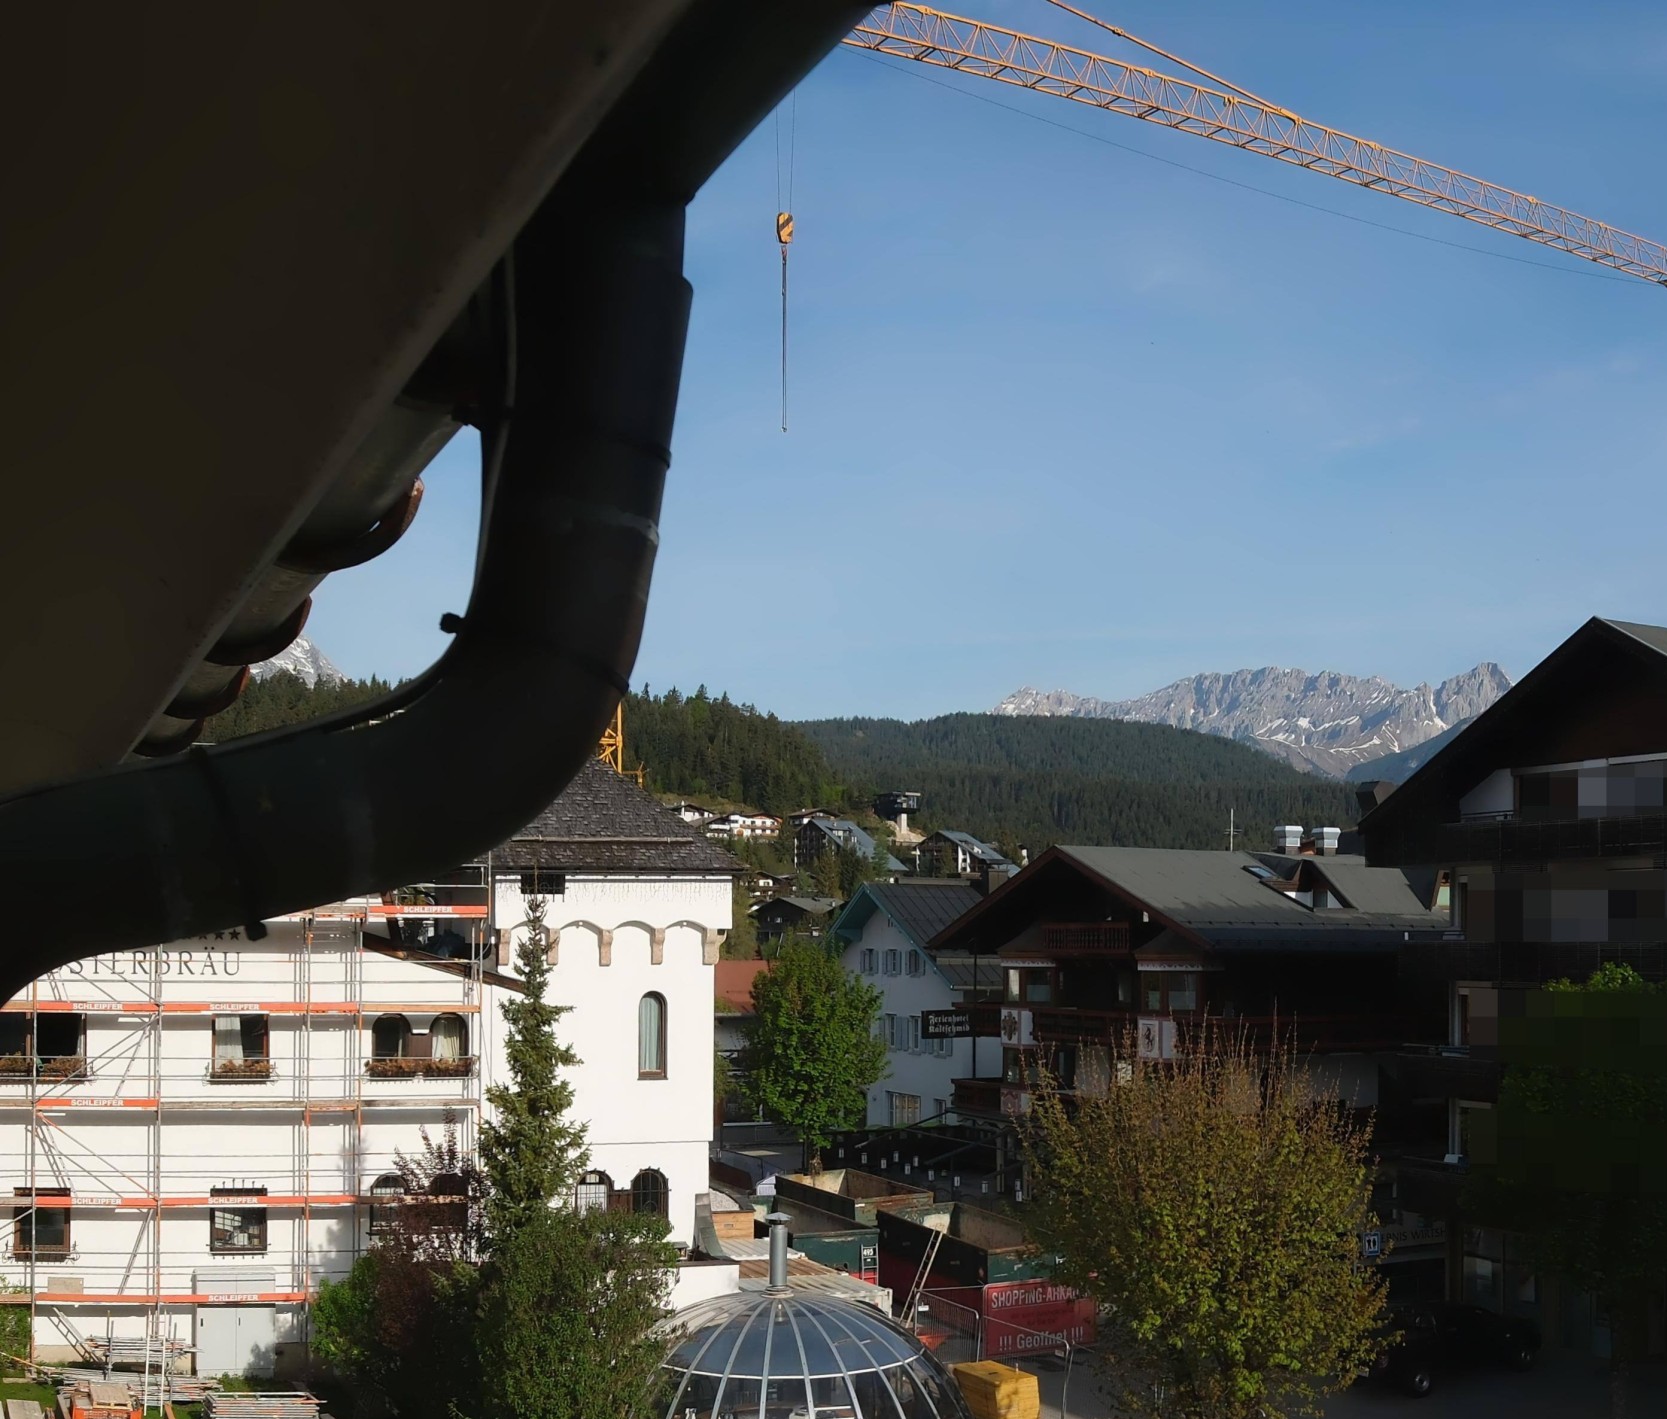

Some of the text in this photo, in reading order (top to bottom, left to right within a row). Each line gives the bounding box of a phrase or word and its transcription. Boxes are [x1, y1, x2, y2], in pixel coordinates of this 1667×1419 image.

[403, 905, 452, 914] SCHLEIPFER
[60, 946, 241, 976] STERBRÄU
[72, 1002, 124, 1011] SCHLEIPFER
[209, 1002, 259, 1011] SCHLEIPFER
[928, 1013, 969, 1025] Ferienhotel
[71, 1099, 124, 1107] SCHLEIPFER
[71, 1197, 122, 1206] SCHLEIPFER
[208, 1196, 258, 1204] SCHLEIPFER
[208, 1294, 259, 1302] SCHLEIPFER
